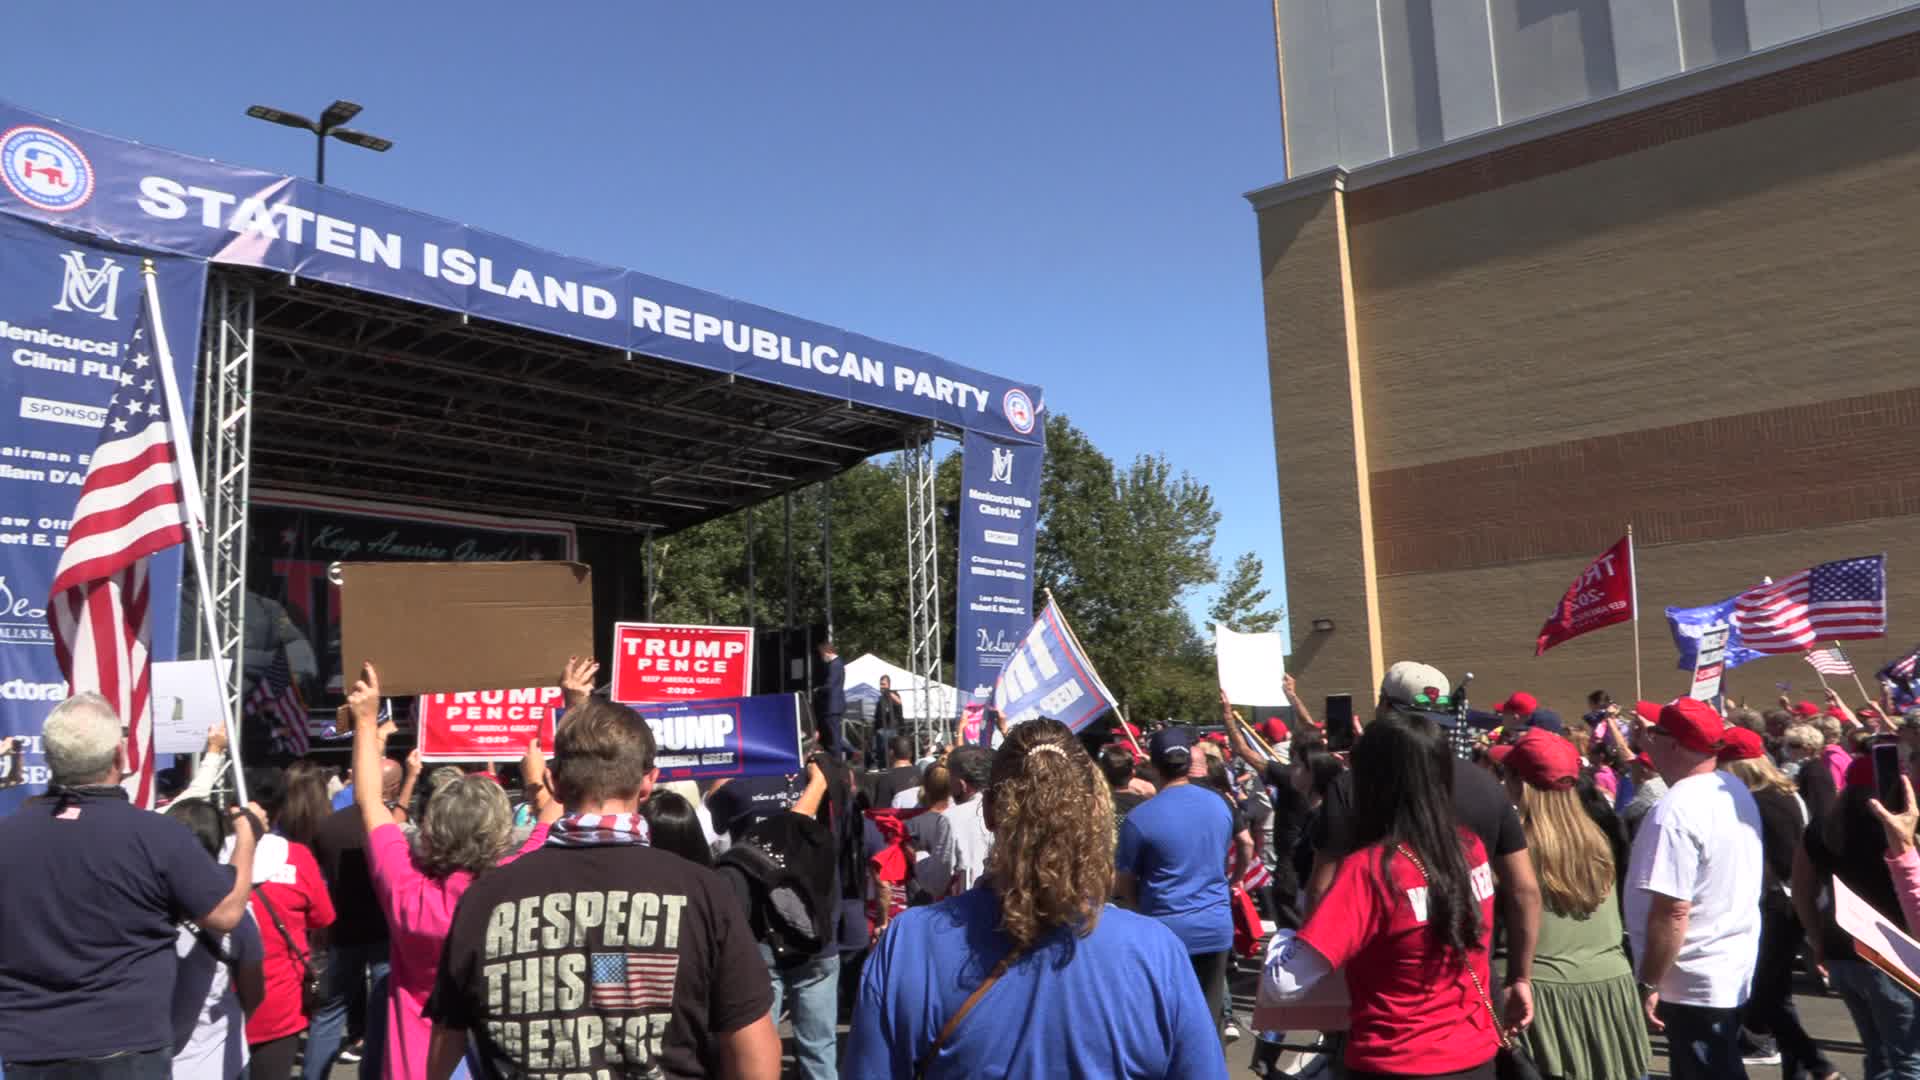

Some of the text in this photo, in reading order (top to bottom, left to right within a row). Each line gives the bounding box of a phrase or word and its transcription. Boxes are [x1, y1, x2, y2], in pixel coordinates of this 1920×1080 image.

[138, 176, 401, 270] STATEN
[423, 242, 618, 320] ISLAND
[633, 296, 885, 387] REPUBLICAN
[894, 365, 990, 413] PARTY
[0, 321, 118, 357] enicucci
[623, 637, 744, 659] TRUMP
[637, 657, 727, 673] PENCE
[446, 706, 544, 720] PENCE
[485, 890, 687, 960] RESPECT
[483, 953, 587, 1016] THIS
[528, 1013, 672, 1069] EXPECT
